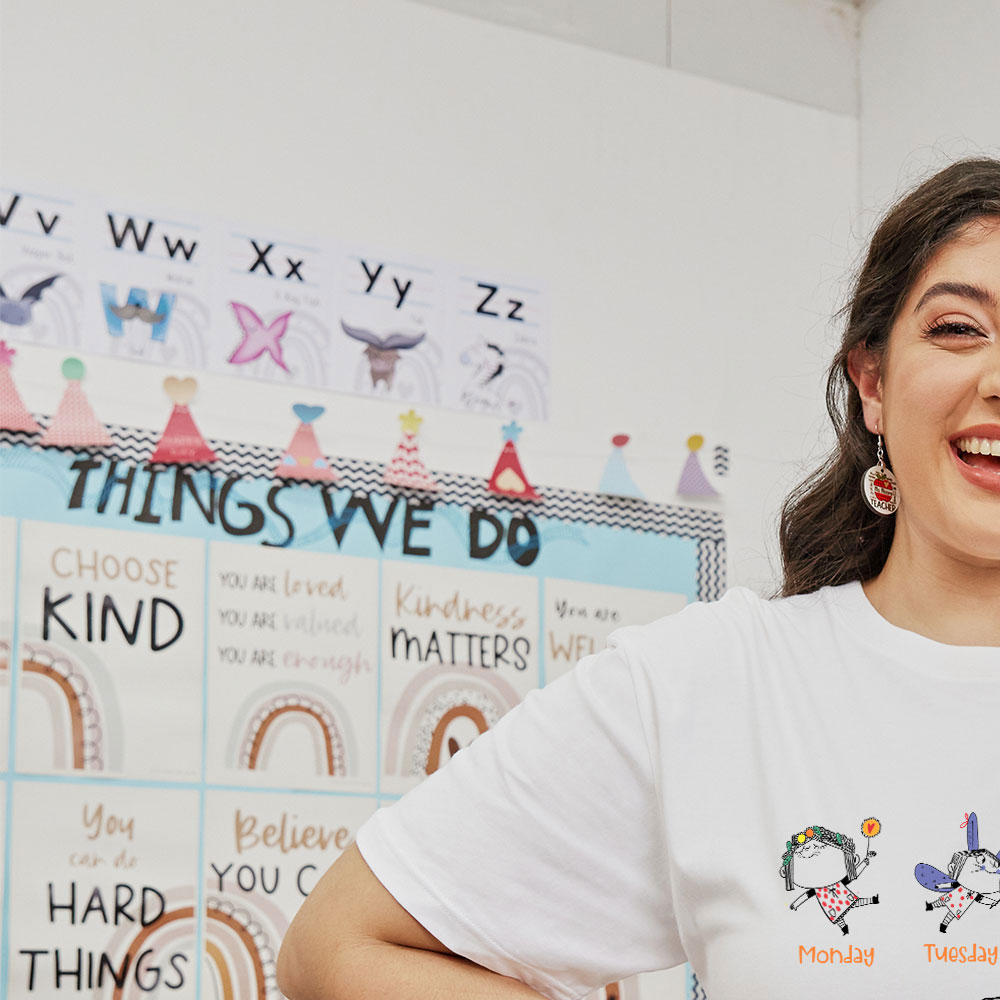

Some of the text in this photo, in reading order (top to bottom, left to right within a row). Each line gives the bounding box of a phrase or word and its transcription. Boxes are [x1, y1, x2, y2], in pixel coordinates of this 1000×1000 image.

[68, 459, 540, 567] THINGS WE DO
[51, 547, 178, 589] CHOOSE
[219, 569, 346, 601] YOU ARE loved
[43, 586, 184, 652] KIND
[218, 608, 248, 627] YOU
[252, 611, 277, 630] ARE
[394, 580, 526, 629] Kindness
[218, 645, 248, 664] YOU
[252, 648, 276, 668] ARE
[82, 803, 135, 840] You
[235, 809, 353, 854] Believe
[211, 863, 279, 894] YOU
[49, 882, 165, 927] HARD
[19, 948, 188, 991] THINGS
[798, 944, 875, 967] Monday
[923, 943, 999, 965] Tuesday
